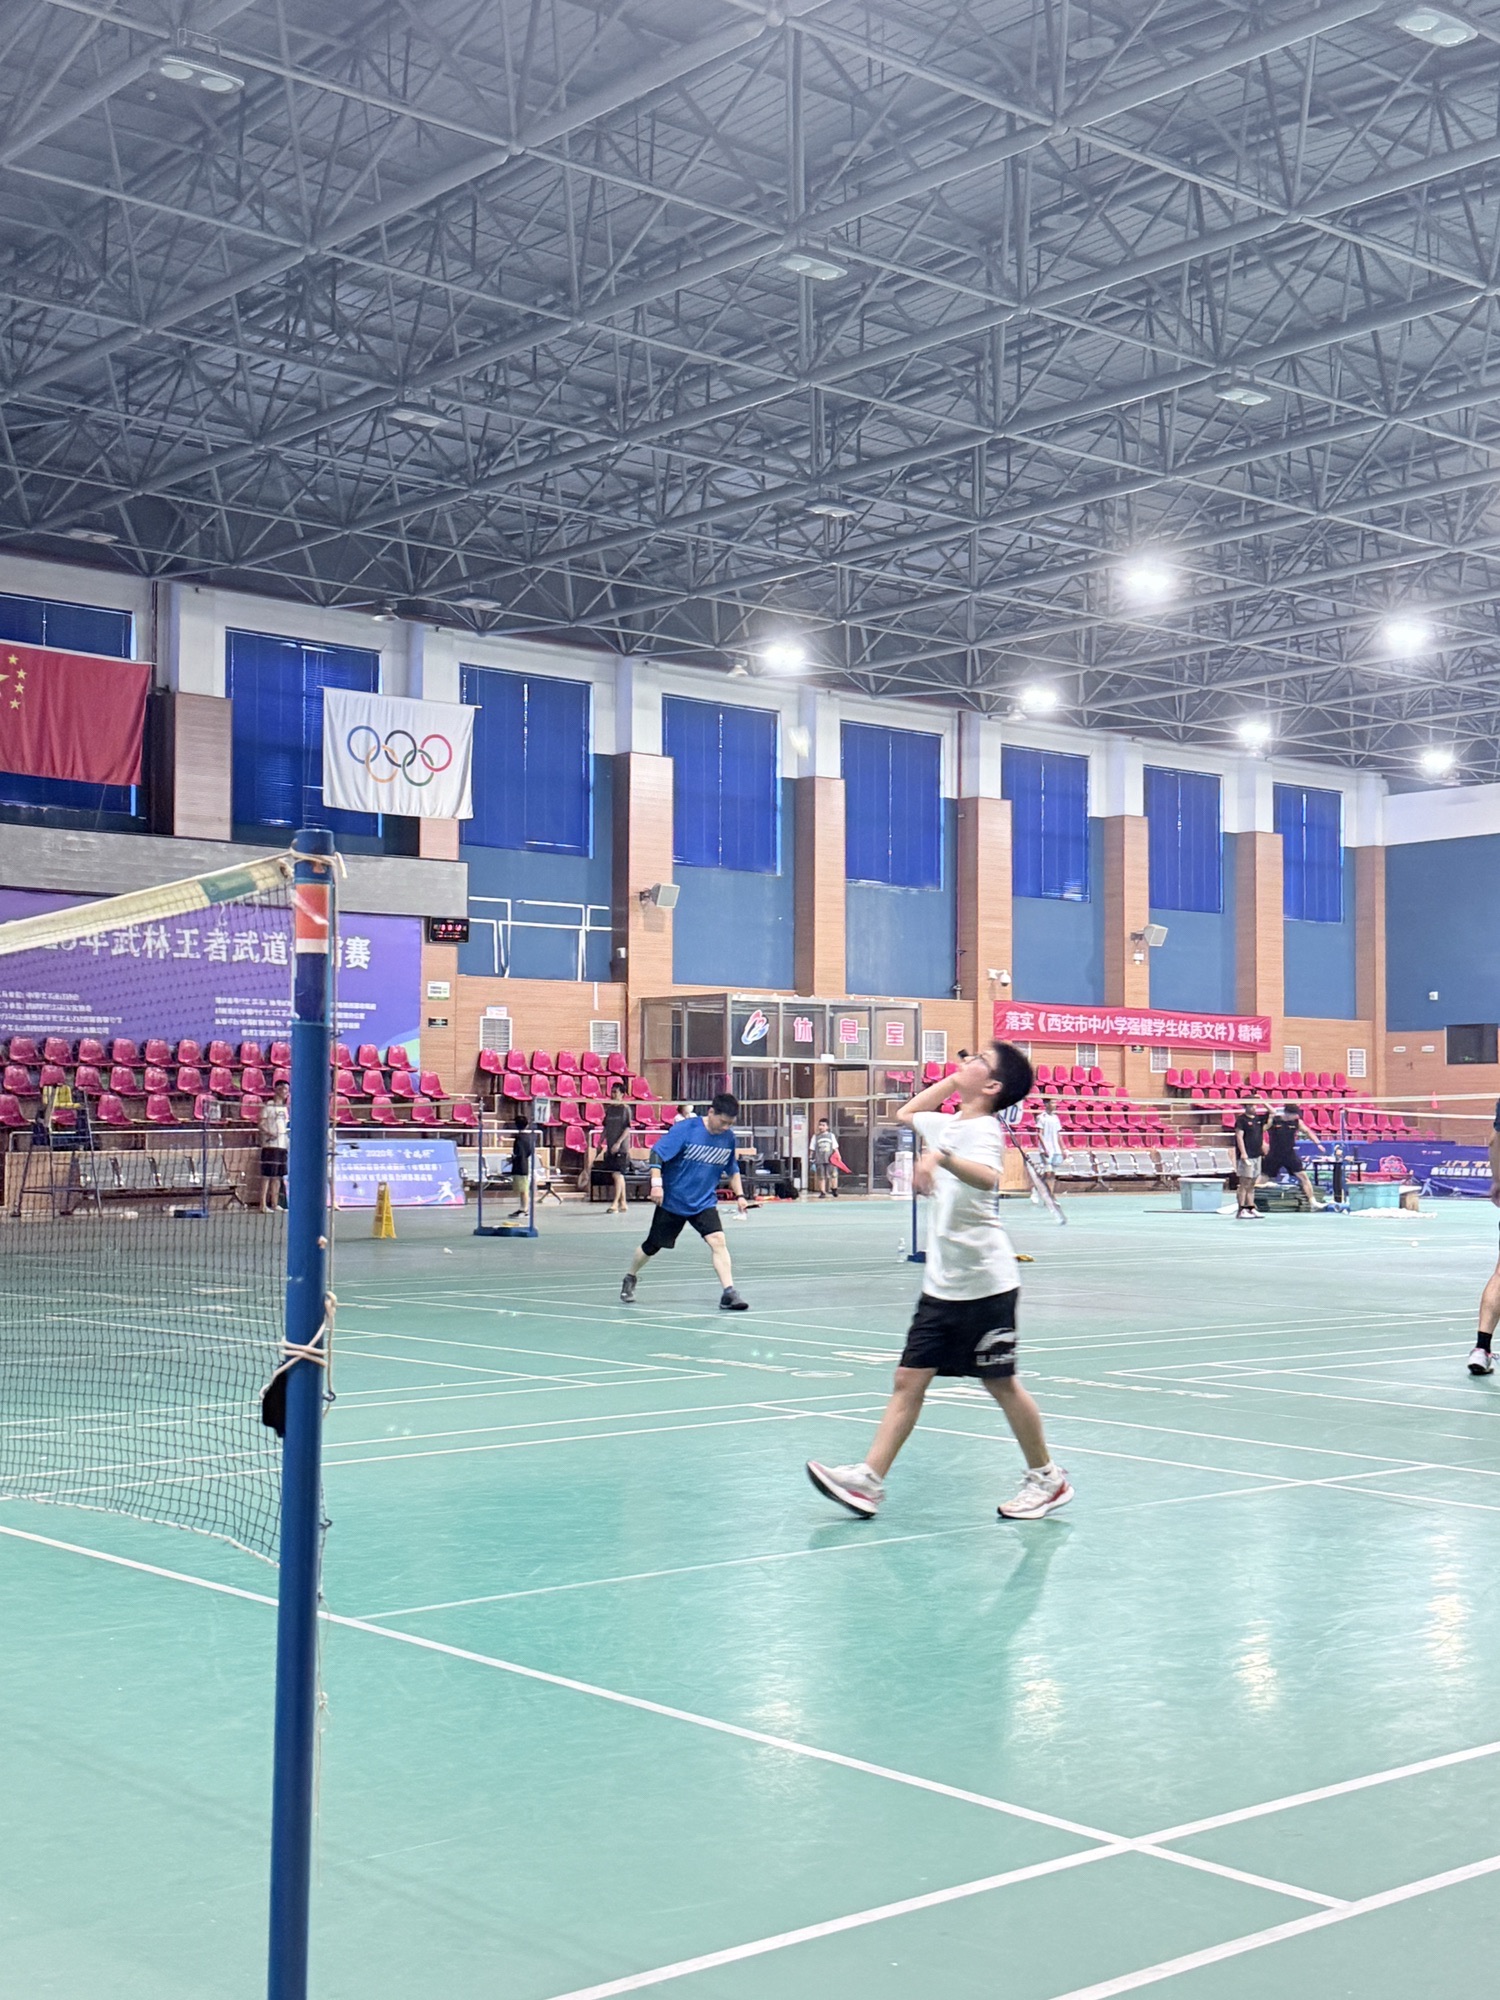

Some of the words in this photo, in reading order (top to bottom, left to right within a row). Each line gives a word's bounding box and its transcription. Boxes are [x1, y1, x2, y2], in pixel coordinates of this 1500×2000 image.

[43, 923, 372, 970] 年武林王者武道赛
[793, 1016, 904, 1046] 休息室
